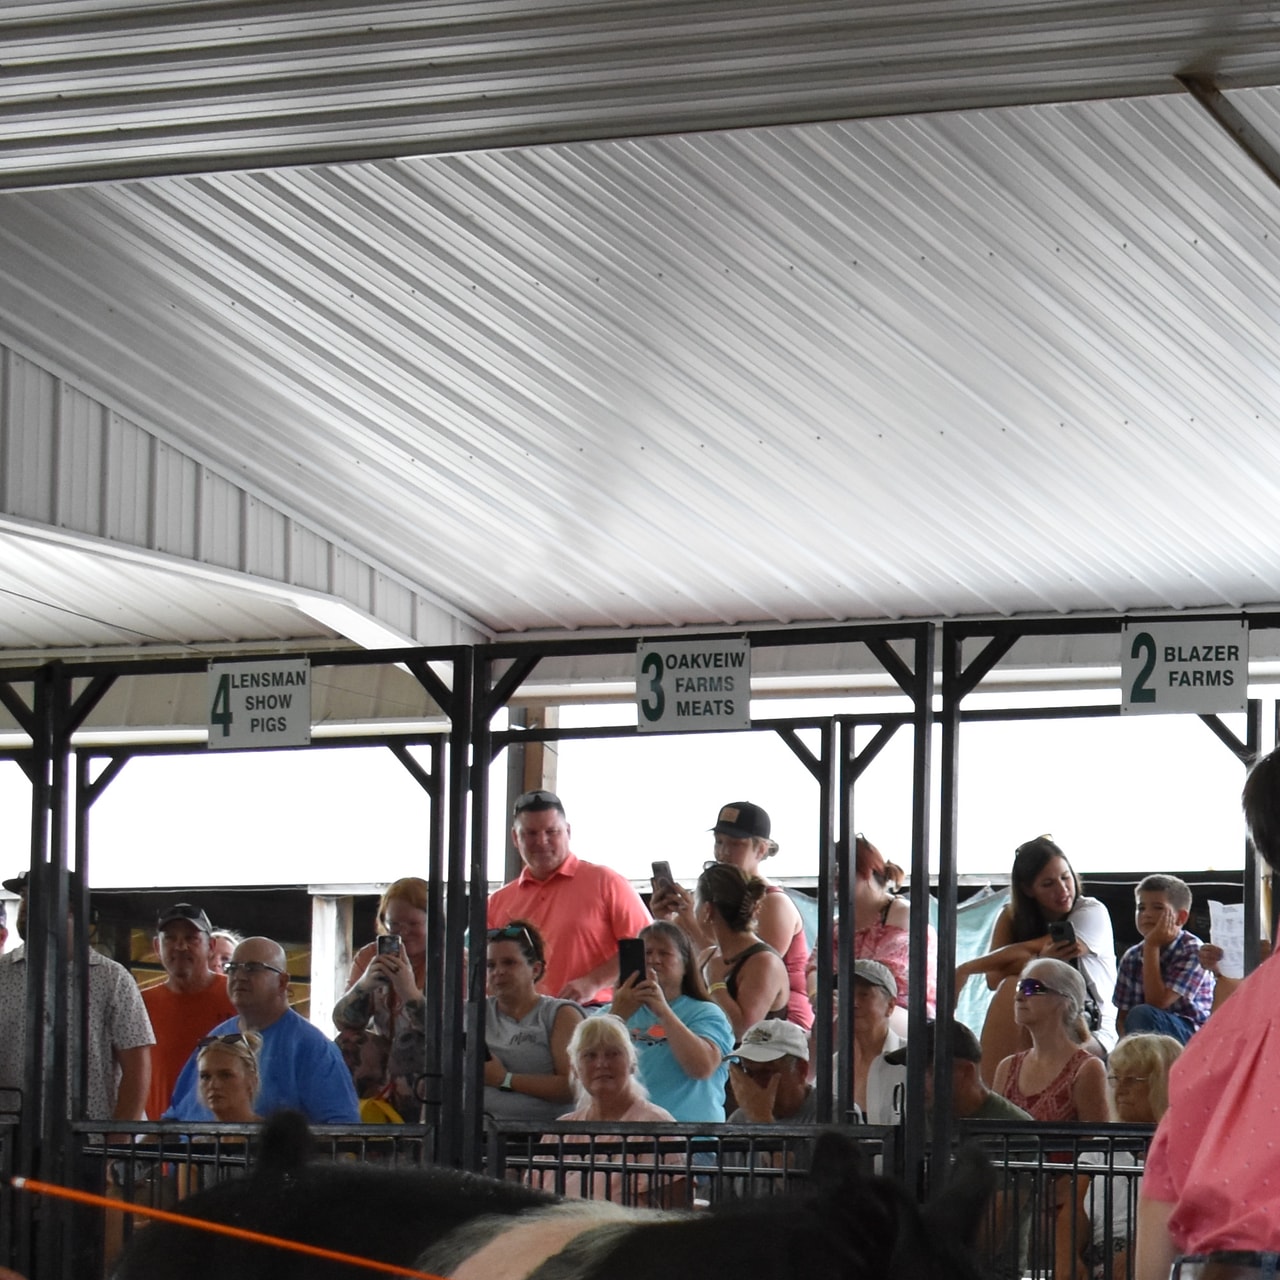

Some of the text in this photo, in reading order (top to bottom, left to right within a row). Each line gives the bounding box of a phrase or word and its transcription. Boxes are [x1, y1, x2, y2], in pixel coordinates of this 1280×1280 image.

[665, 652, 745, 670] OAKVEIW
[1164, 645, 1239, 662] BLAZER
[1130, 632, 1157, 703] 2
[231, 670, 307, 689] LENSMAN
[641, 652, 665, 722] 3
[675, 676, 734, 693] FARMS
[1169, 669, 1234, 687] FARMS
[211, 673, 233, 737] 4
[245, 694, 292, 711] SHOW
[676, 699, 734, 716] MEATS
[250, 716, 287, 733] PIGS
